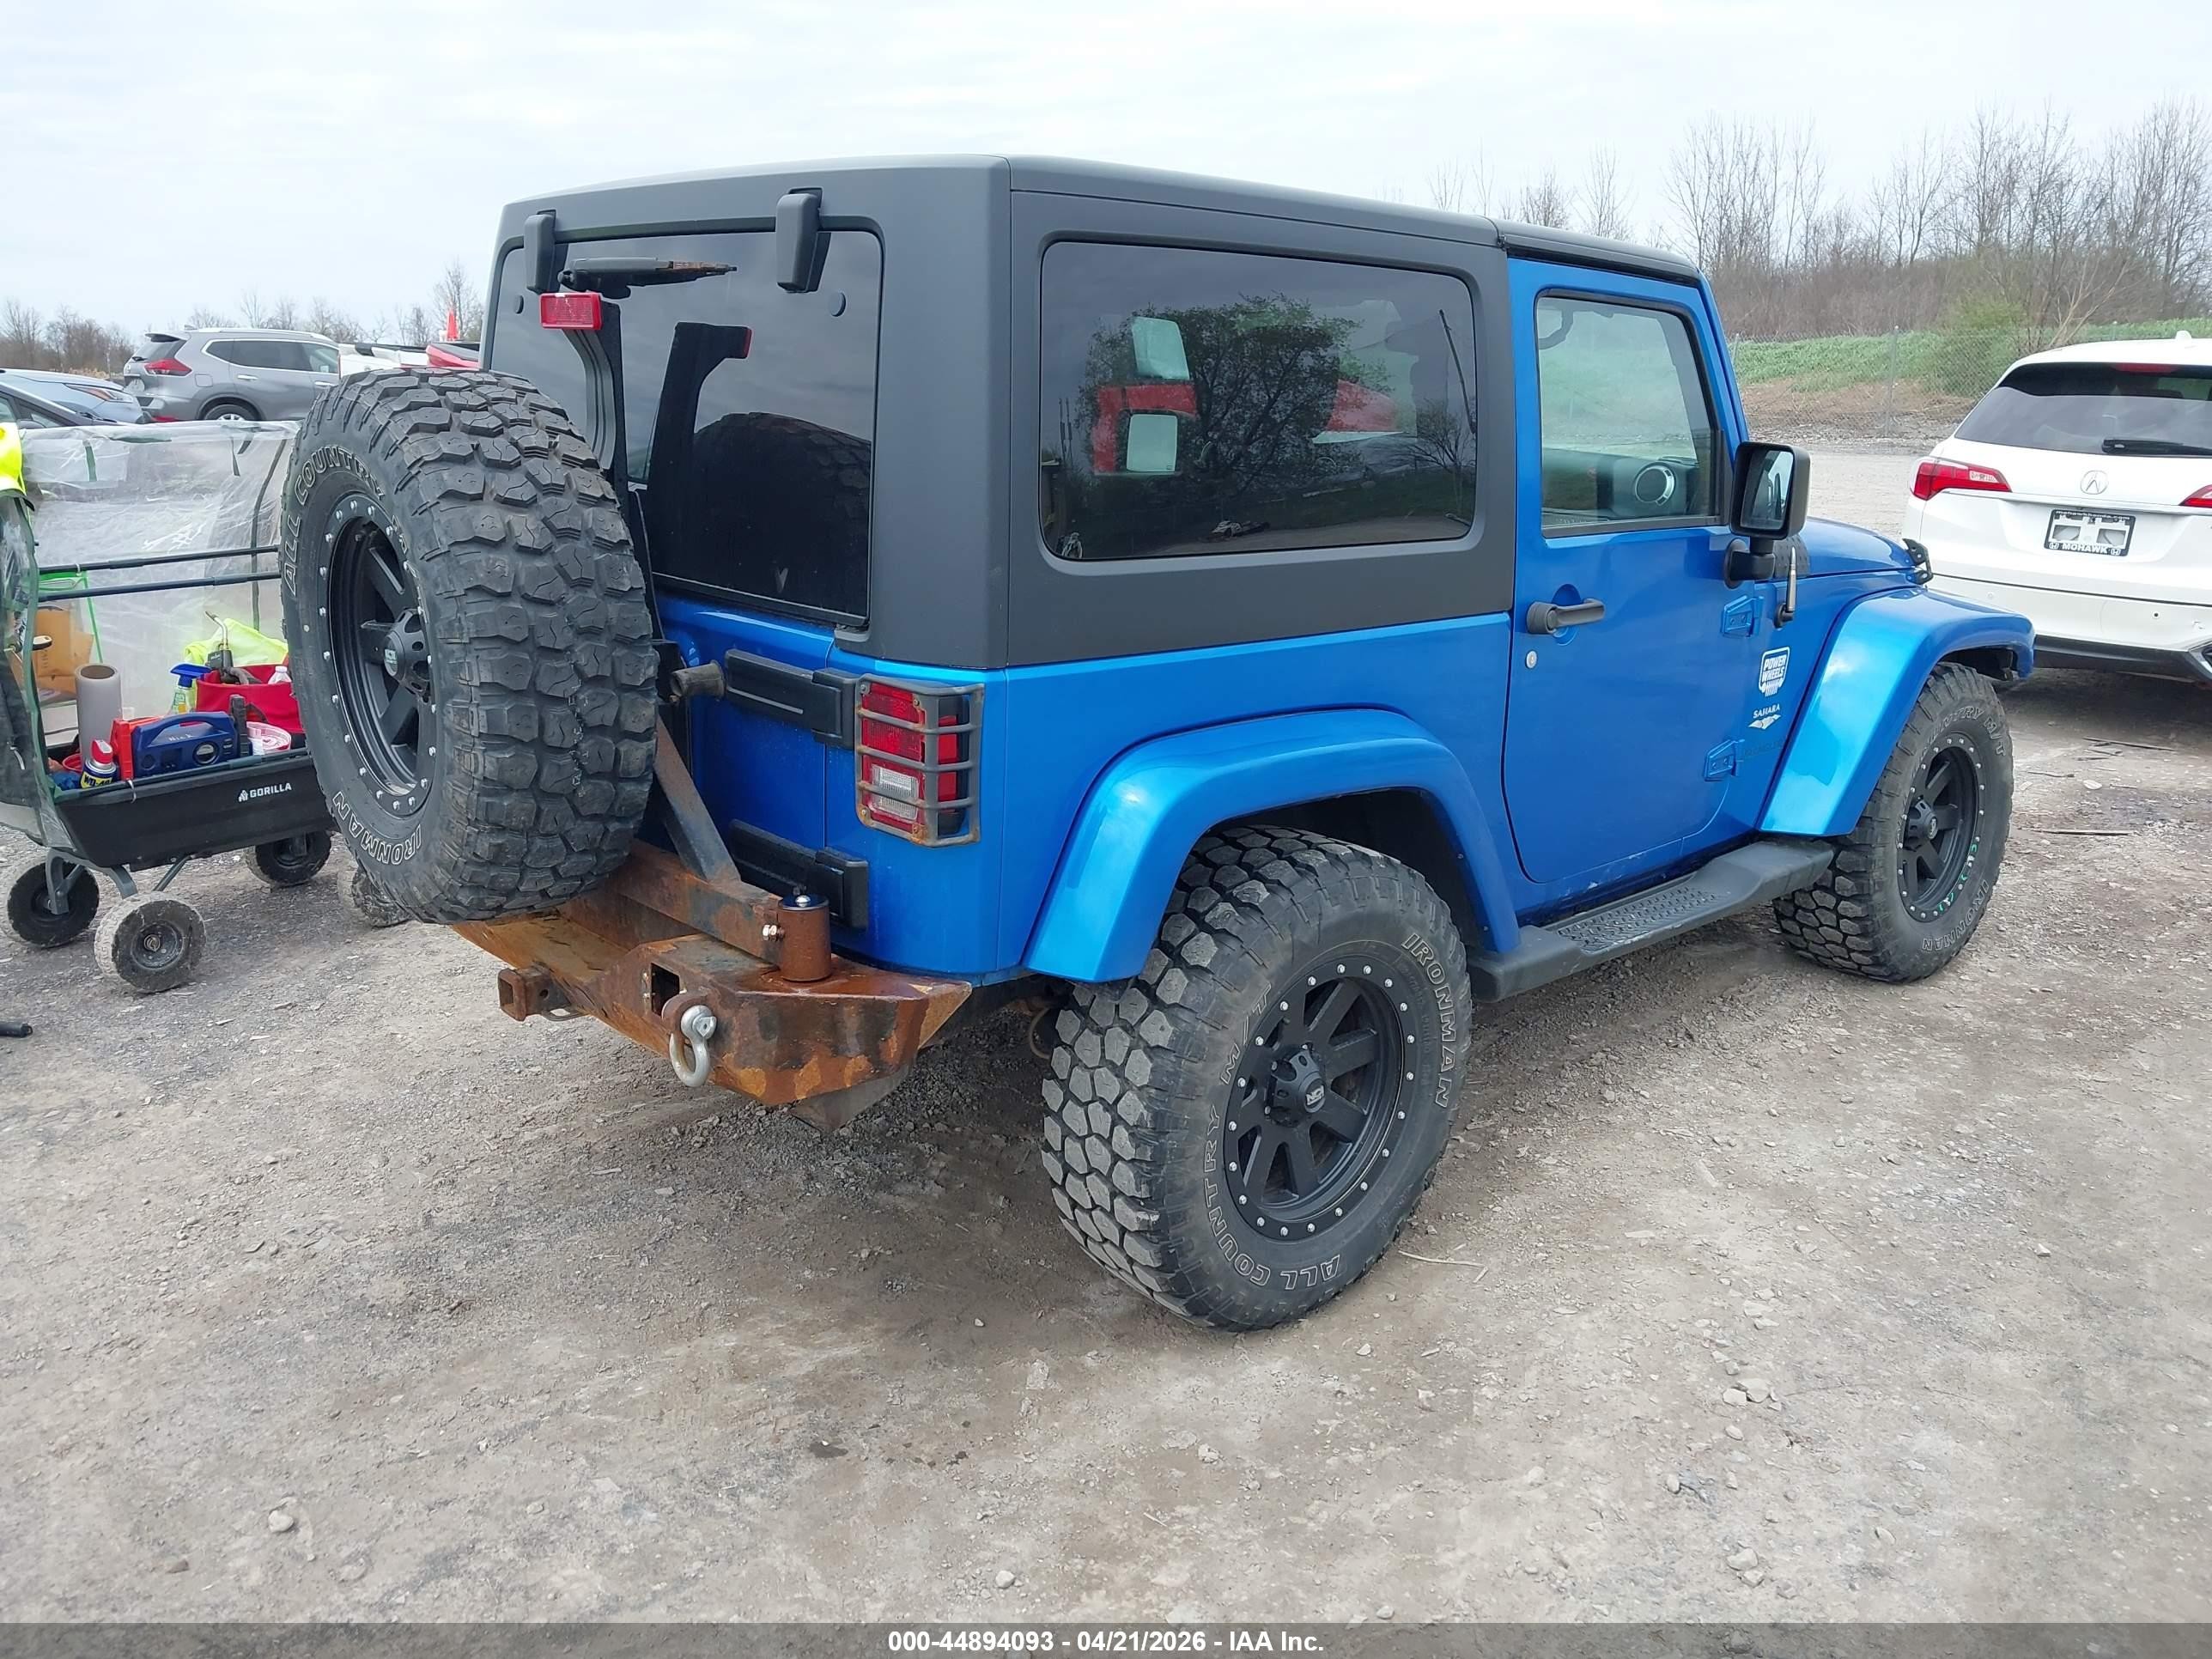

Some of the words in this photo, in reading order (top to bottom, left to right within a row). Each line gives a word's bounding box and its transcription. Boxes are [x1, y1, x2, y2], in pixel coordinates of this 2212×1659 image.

[284, 515, 301, 597] ALL
[295, 446, 386, 506] COUNTRY
[2063, 543, 2108, 554] MOHAWK
[1762, 666, 1785, 683] WHEELS
[1763, 654, 1787, 671] POWER
[1753, 703, 1780, 719] SAHARA
[249, 782, 292, 798] GORILLA
[332, 791, 422, 865] IRONMAN
[1923, 879, 1989, 951] IRONMAN
[1401, 933, 1456, 1108] IRONMAN
[1204, 1104, 1271, 1287] COUNTRY
[1280, 1254, 1340, 1290] ALL
